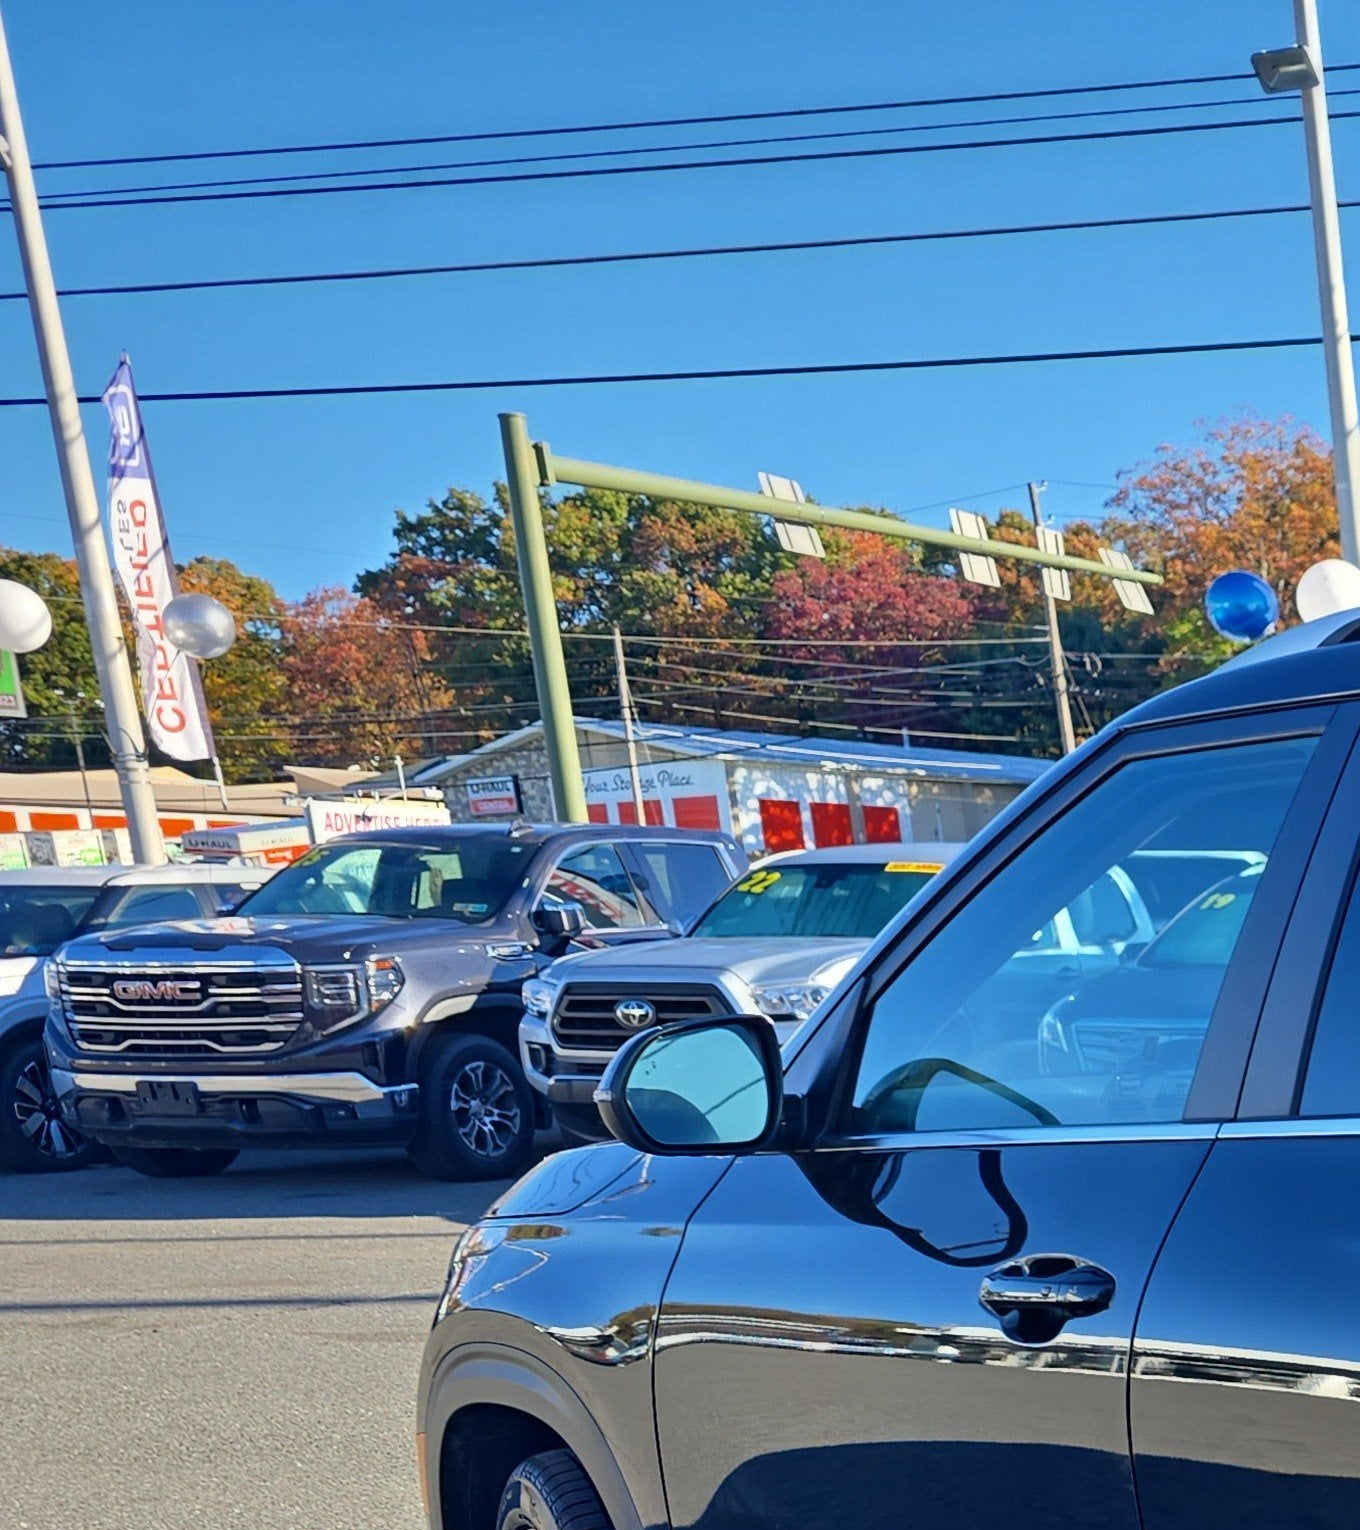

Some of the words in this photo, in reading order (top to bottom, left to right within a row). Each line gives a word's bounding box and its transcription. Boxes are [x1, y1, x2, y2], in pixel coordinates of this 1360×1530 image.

[611, 774, 657, 793] Stoge
[657, 770, 695, 787] Place
[737, 870, 781, 894] 22
[113, 981, 202, 1000] GMC
